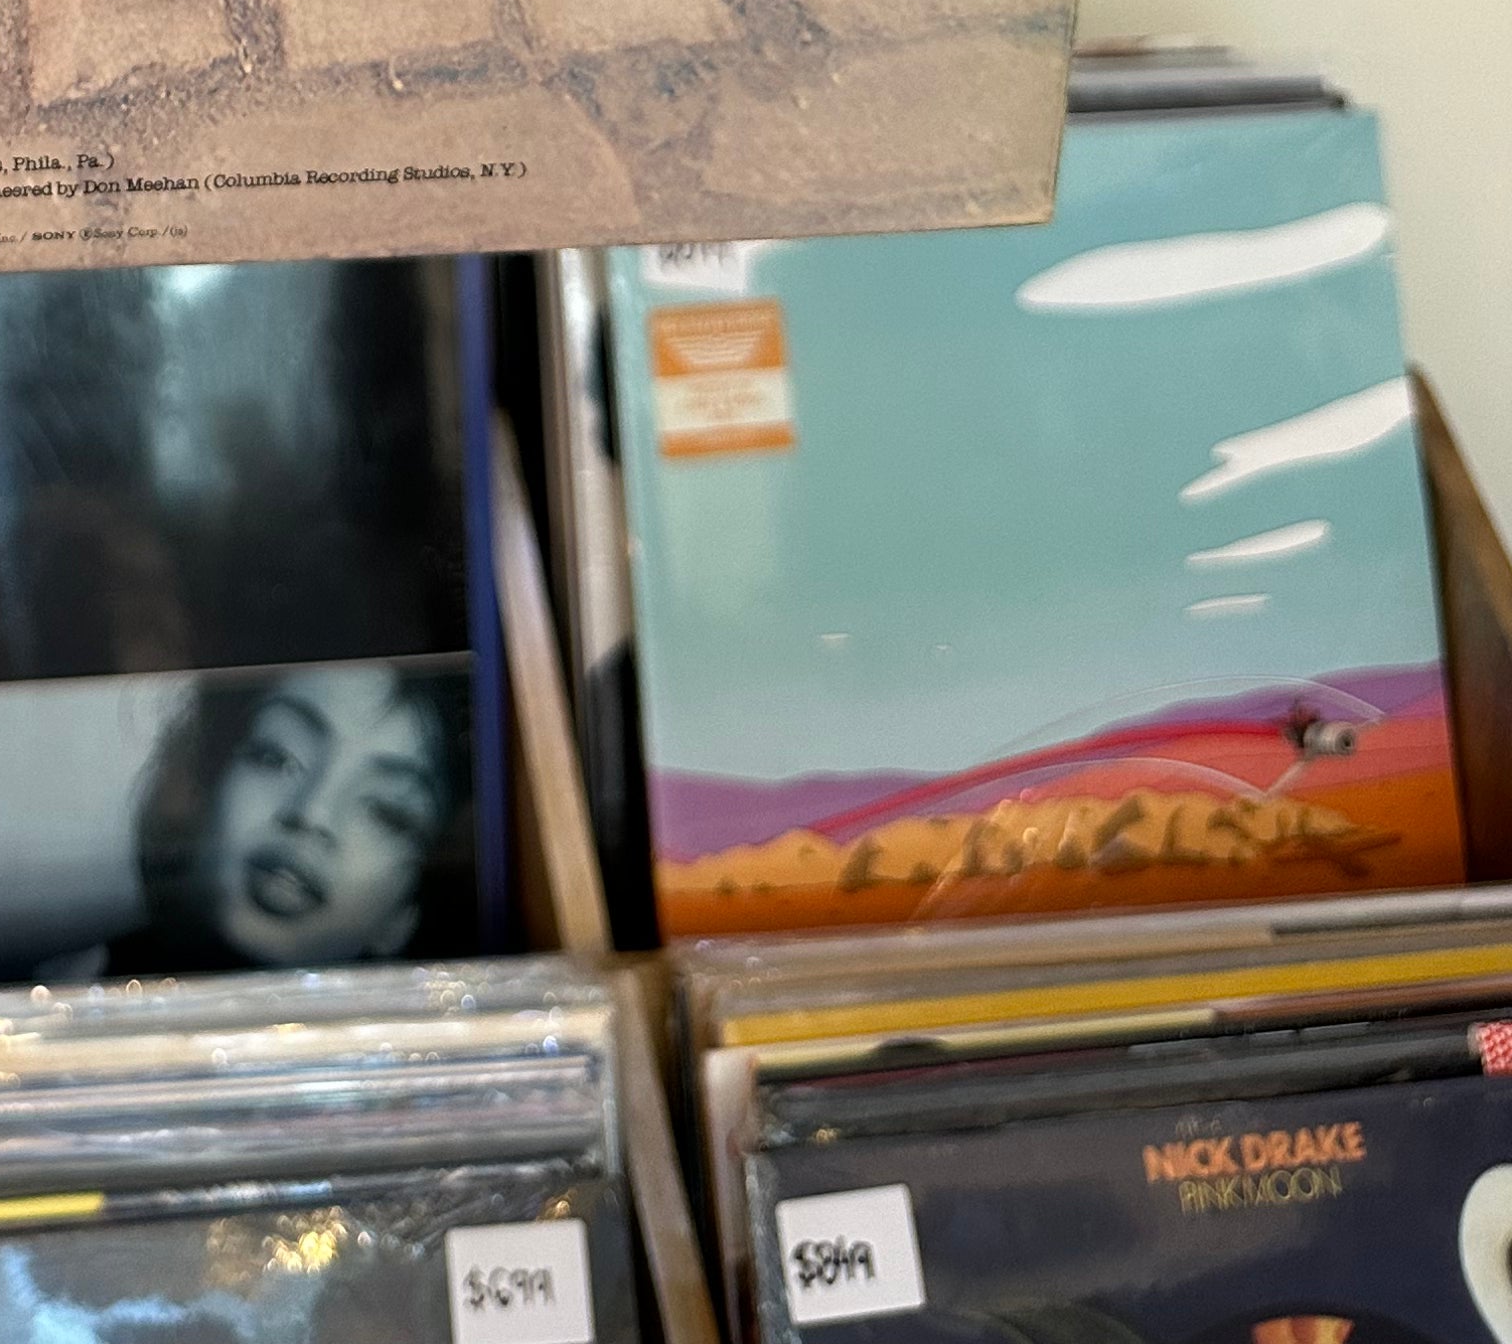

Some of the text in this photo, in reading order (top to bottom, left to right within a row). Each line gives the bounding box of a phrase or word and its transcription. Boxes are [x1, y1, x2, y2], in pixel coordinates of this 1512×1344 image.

[56, 180, 81, 198] by
[81, 180, 121, 199] Don
[124, 177, 200, 197] Meehan
[204, 172, 302, 191] (Columbia
[306, 168, 400, 186] Recording
[403, 165, 475, 183] Studios,
[1143, 1135, 1238, 1184] NICK
[1240, 1121, 1367, 1172] DRAKE
